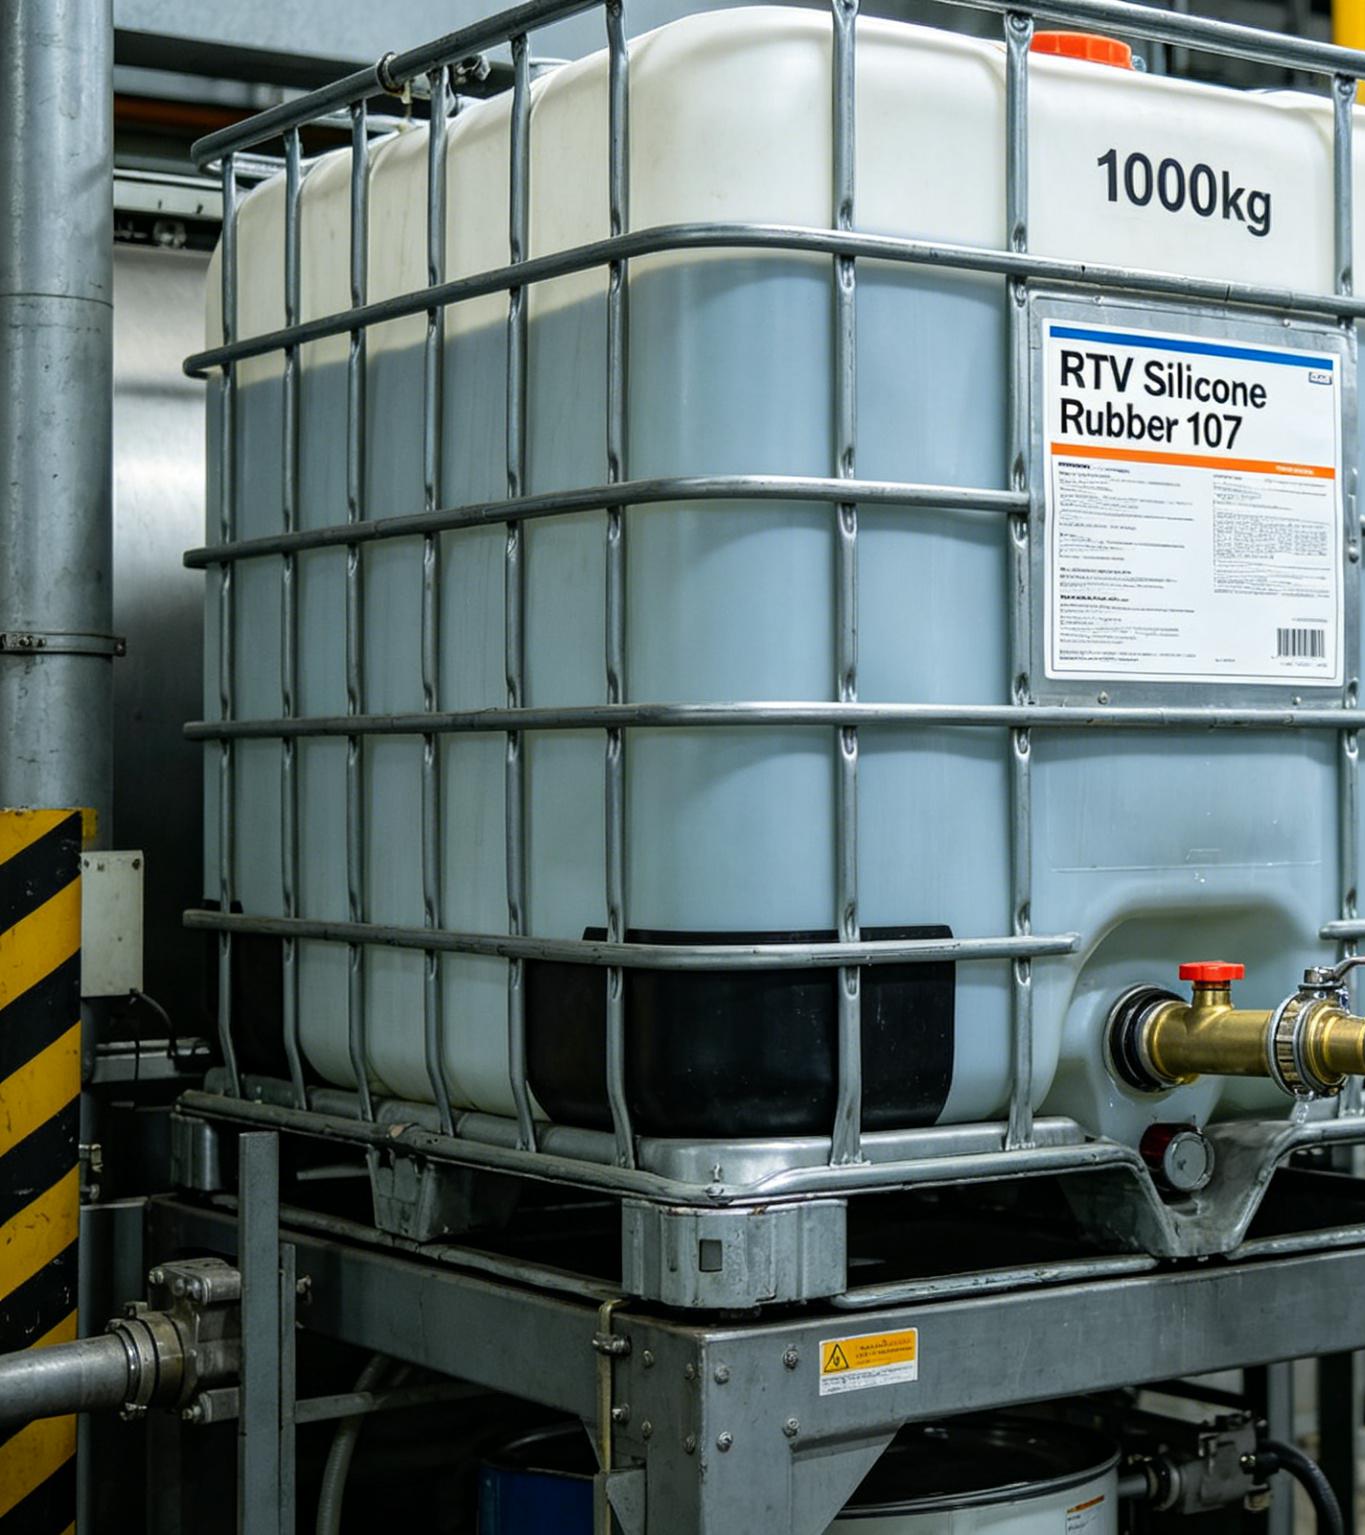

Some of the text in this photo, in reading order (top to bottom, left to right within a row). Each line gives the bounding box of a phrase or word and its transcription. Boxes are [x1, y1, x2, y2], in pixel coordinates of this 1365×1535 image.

[1097, 148, 1271, 237] 1000kg
[1060, 349, 1267, 409] RTV Silicone
[1060, 397, 1243, 450] Rubber 107
